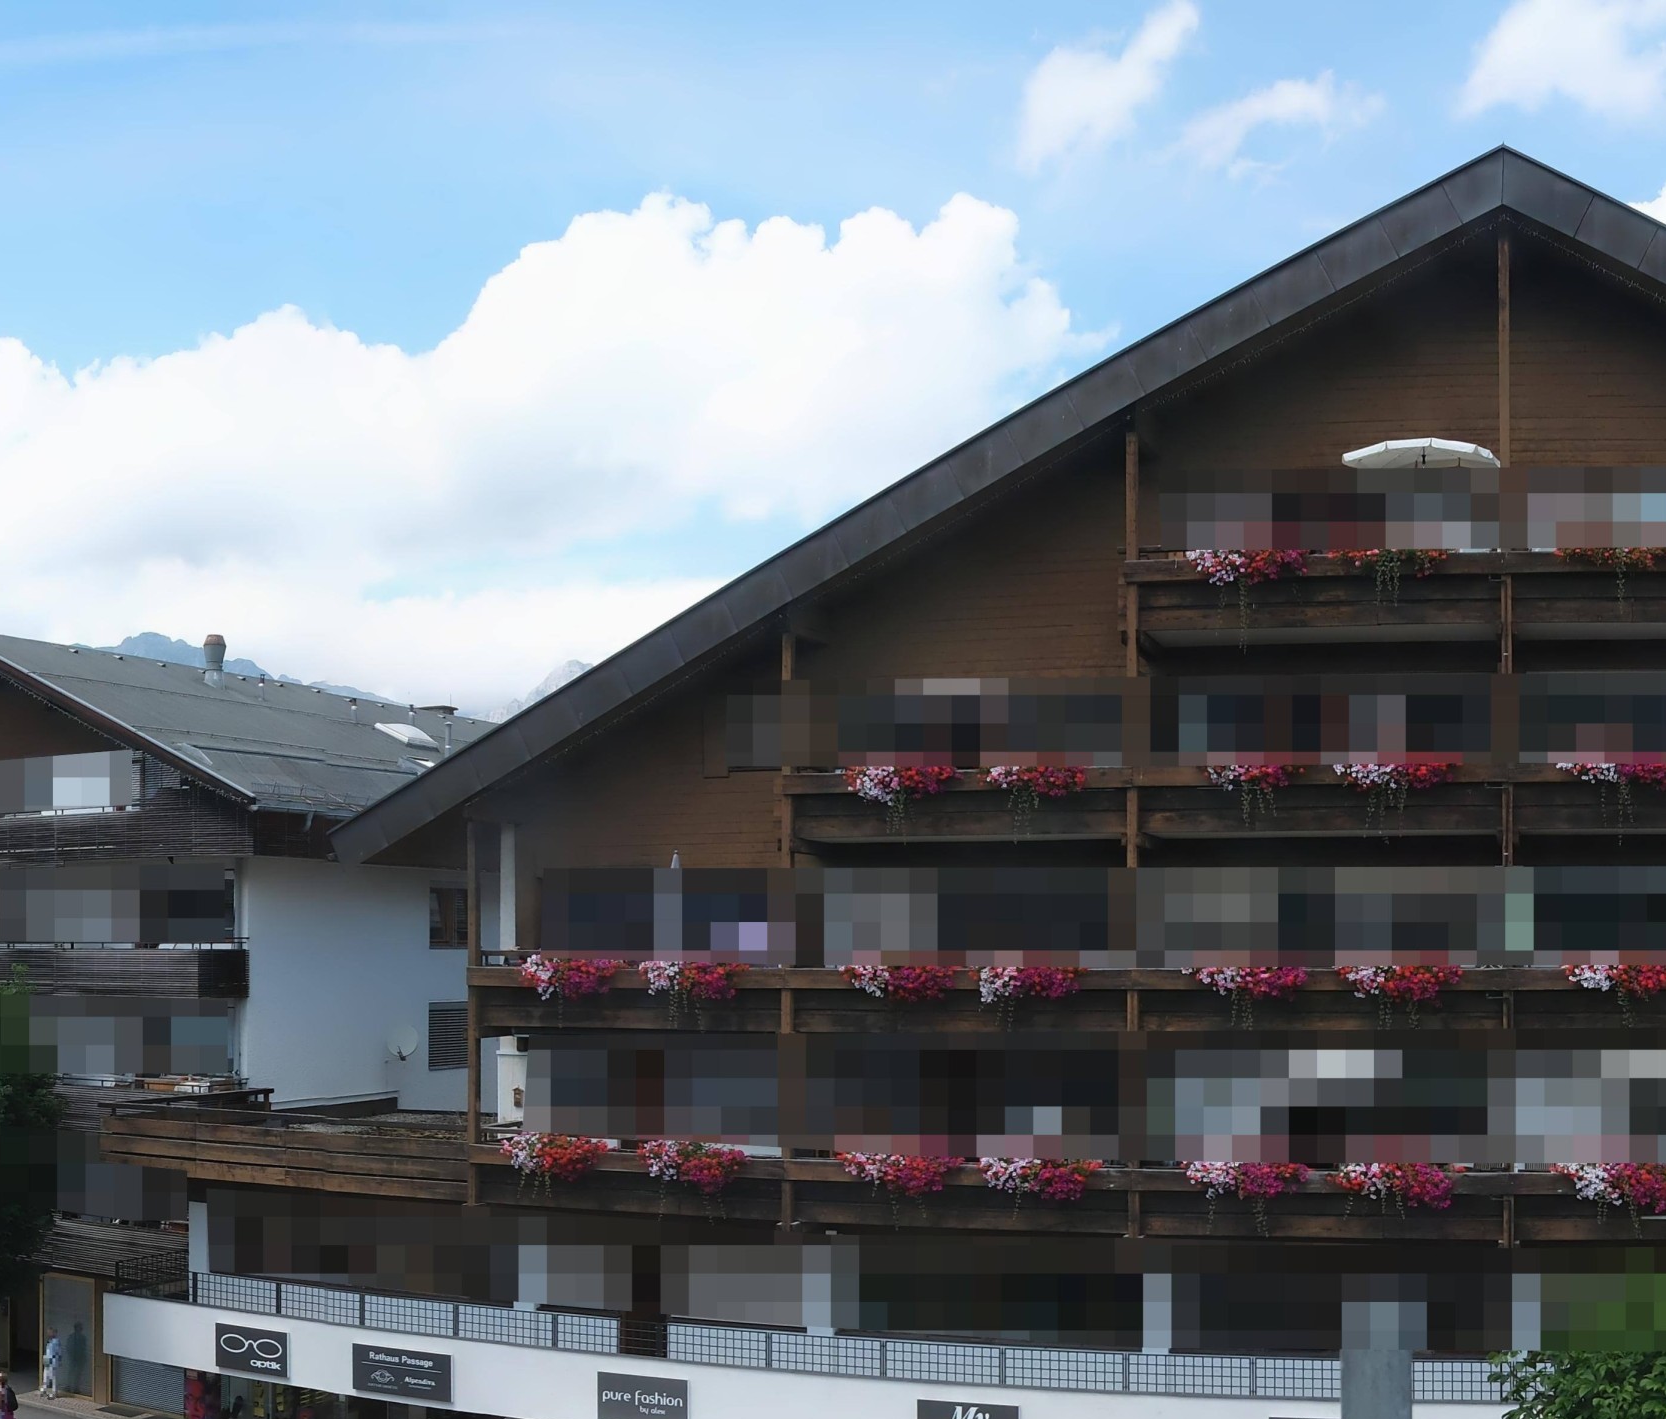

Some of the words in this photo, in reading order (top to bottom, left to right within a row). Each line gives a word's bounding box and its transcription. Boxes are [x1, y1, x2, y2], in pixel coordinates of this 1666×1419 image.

[250, 1359, 282, 1371] optik
[369, 1351, 399, 1363] Rathaus
[402, 1354, 434, 1368] Passage
[602, 1390, 631, 1402] pure
[635, 1390, 683, 1407] fashion
[639, 1405, 649, 1415] by
